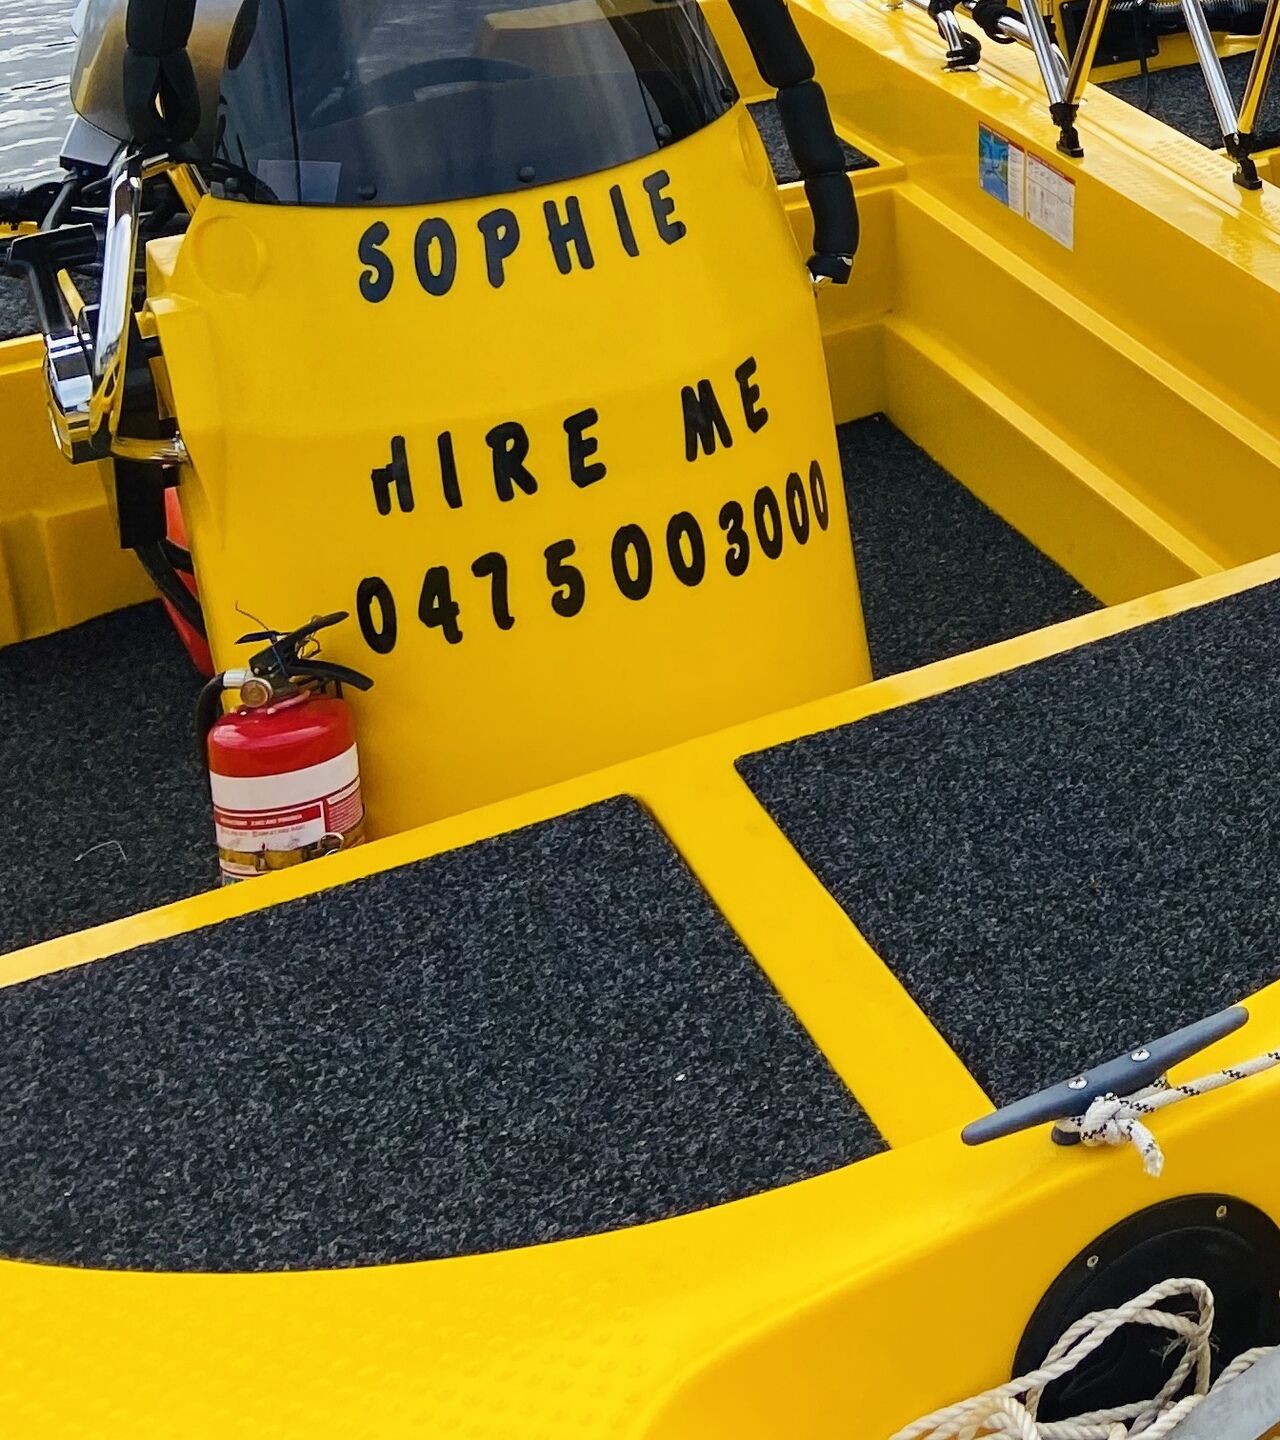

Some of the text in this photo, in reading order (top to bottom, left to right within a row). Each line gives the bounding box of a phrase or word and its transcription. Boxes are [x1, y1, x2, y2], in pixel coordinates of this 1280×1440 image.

[356, 169, 688, 304] SOPHIE
[370, 356, 769, 516] HIRE ME
[355, 458, 830, 655] 0475003000
